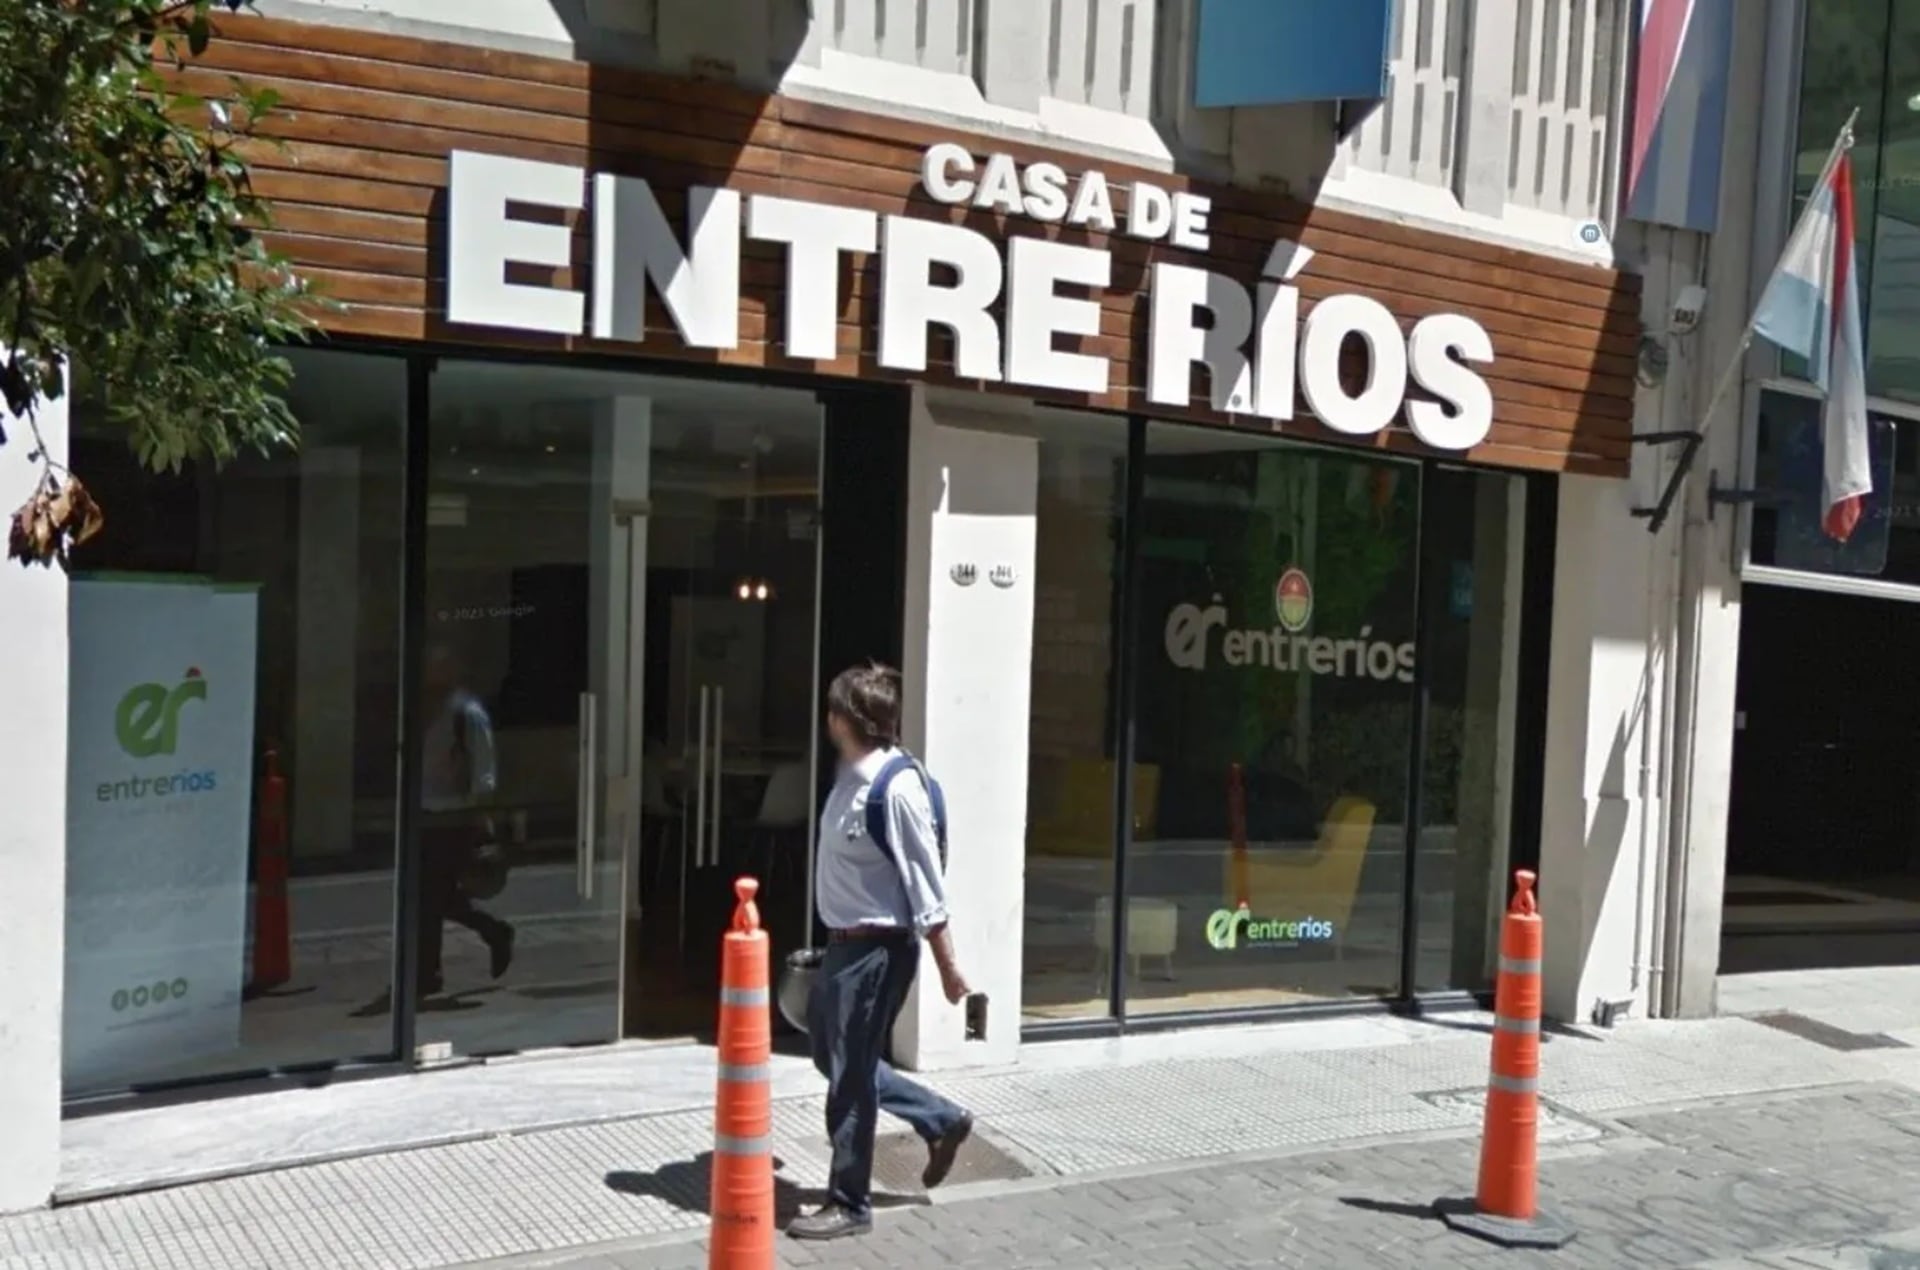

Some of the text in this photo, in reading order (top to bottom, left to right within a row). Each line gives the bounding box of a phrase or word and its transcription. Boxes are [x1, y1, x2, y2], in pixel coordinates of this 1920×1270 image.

[446, 148, 1495, 451] ENTRE RÍOS
[921, 142, 1211, 251] CASA DE
